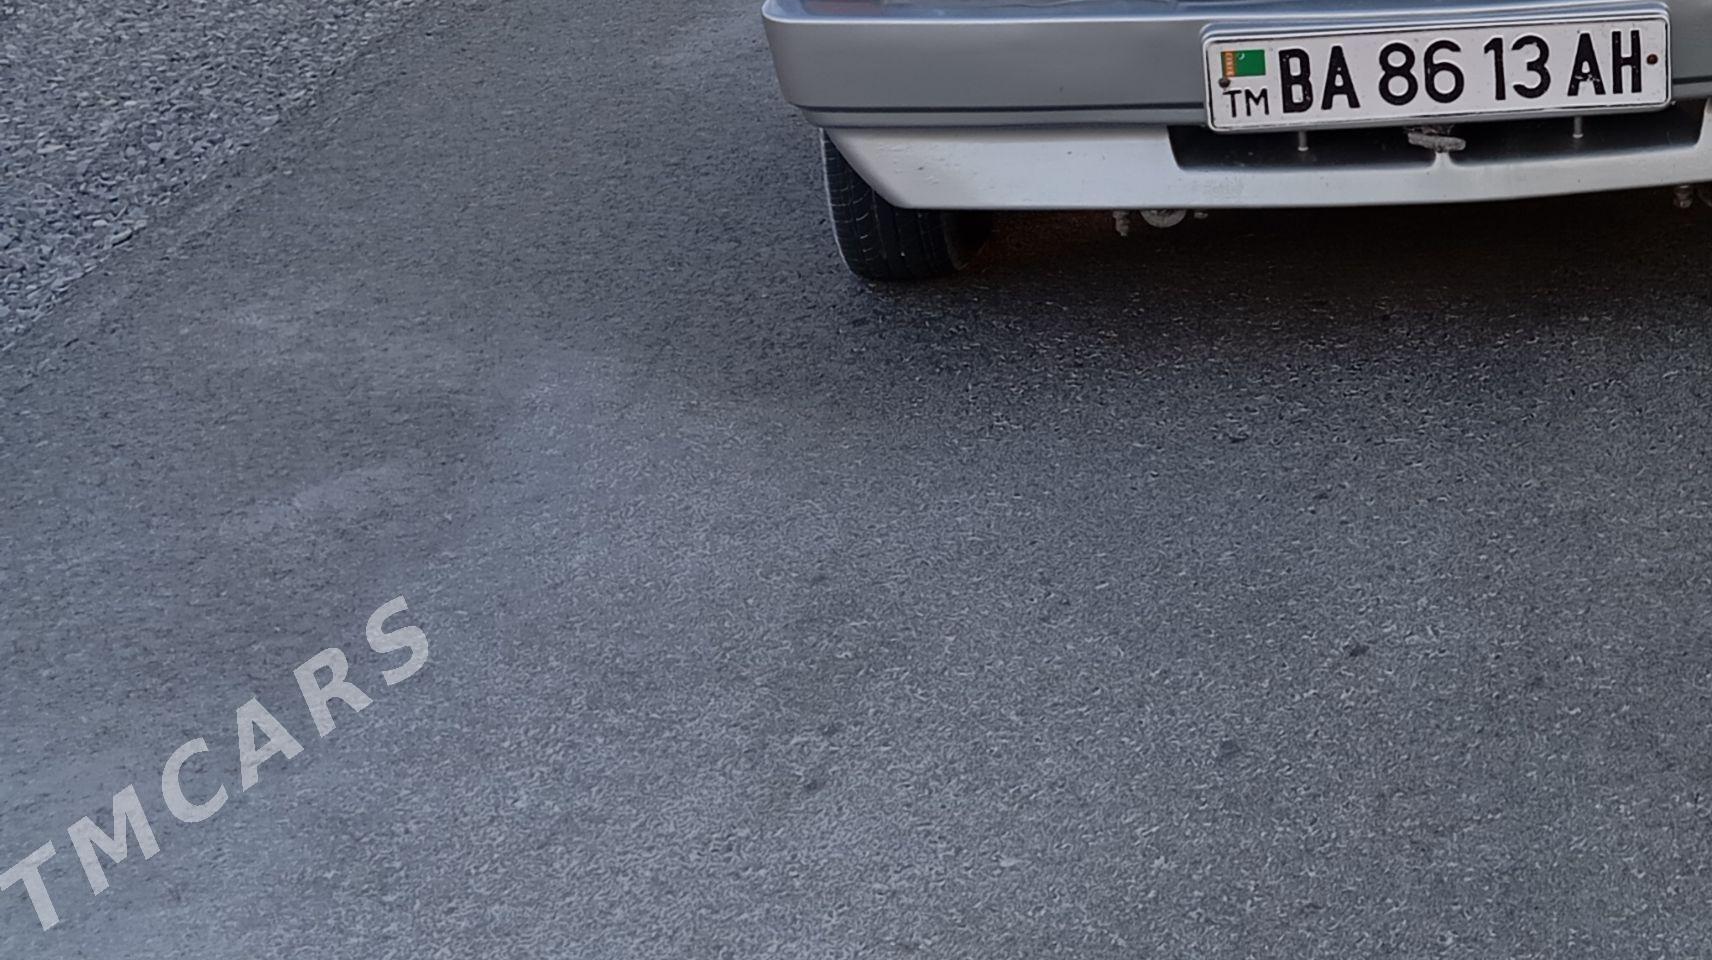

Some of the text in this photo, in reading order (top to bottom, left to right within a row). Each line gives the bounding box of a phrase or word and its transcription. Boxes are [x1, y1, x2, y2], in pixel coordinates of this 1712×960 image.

[1278, 29, 1643, 113] BA 86 13 AH
[1223, 87, 1270, 118] TM
